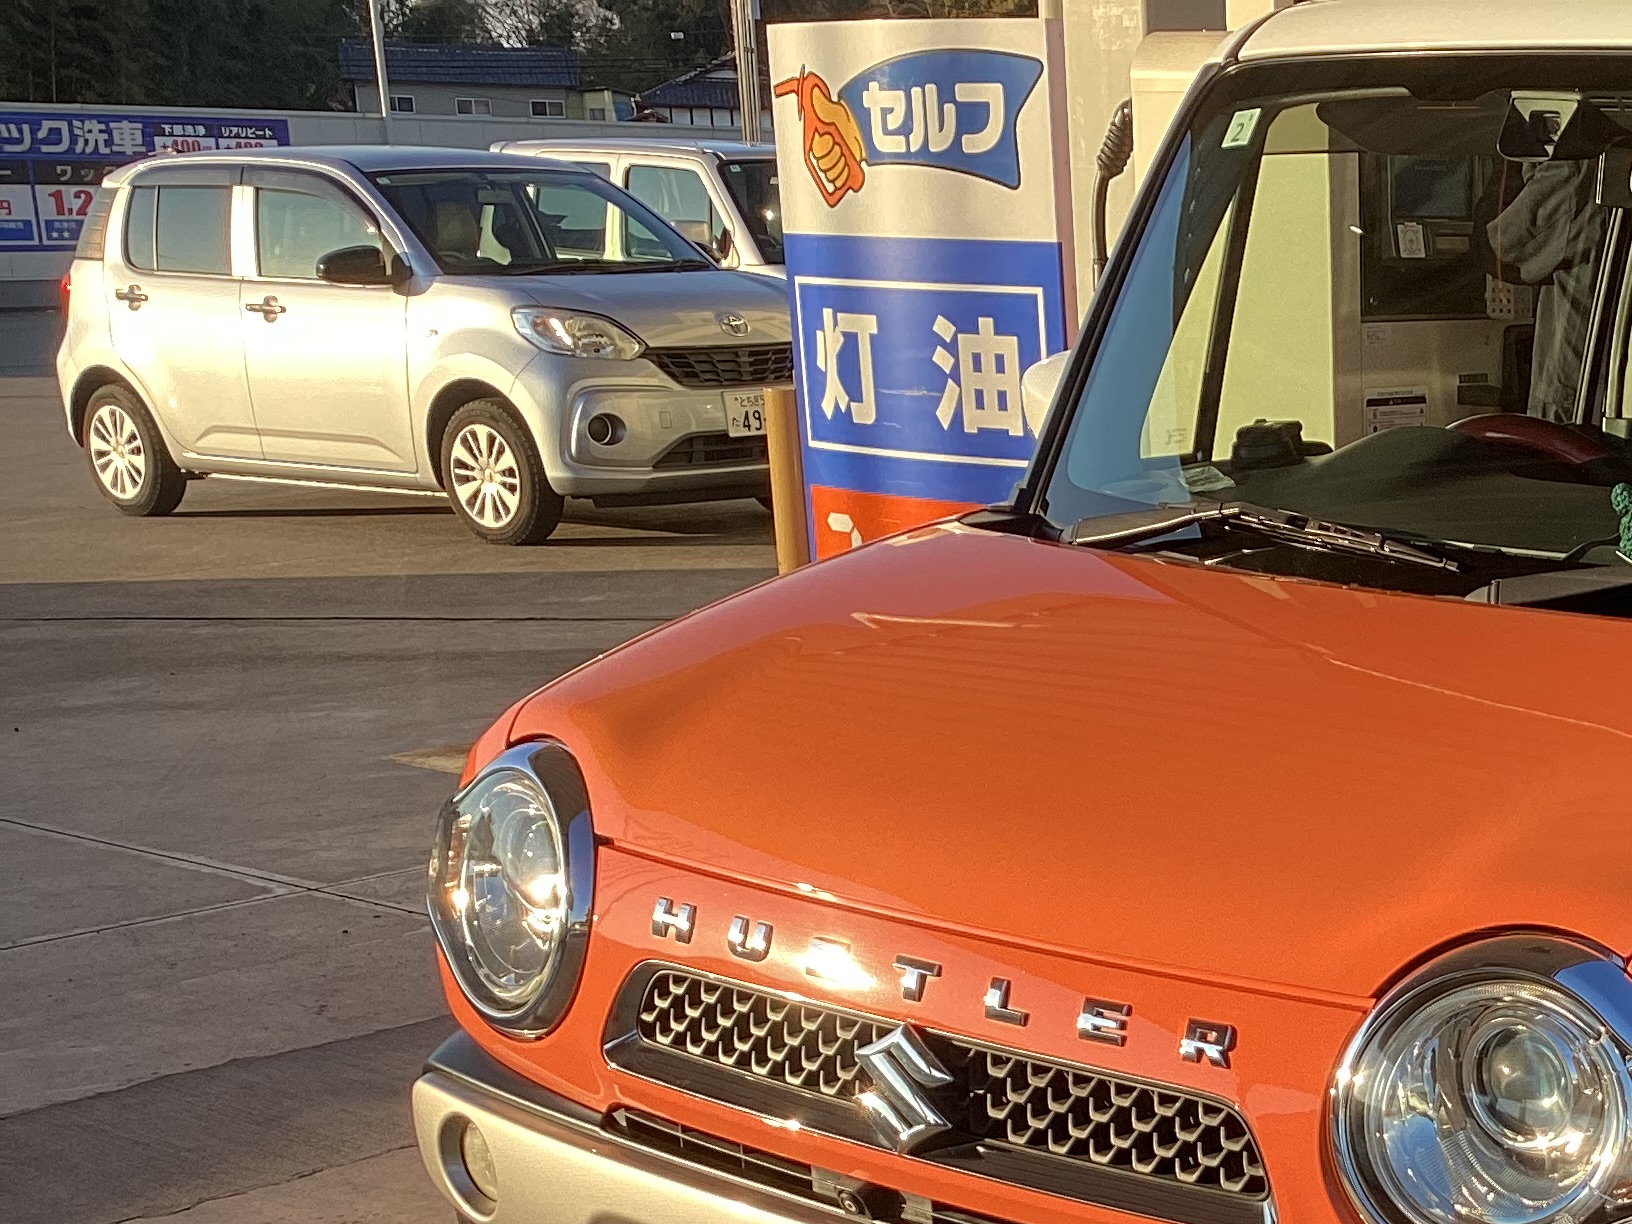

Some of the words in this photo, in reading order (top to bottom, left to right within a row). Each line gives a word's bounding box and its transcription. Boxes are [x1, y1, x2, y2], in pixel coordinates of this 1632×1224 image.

[862, 82, 1004, 153] セルフ
[817, 308, 1025, 437] 灯油
